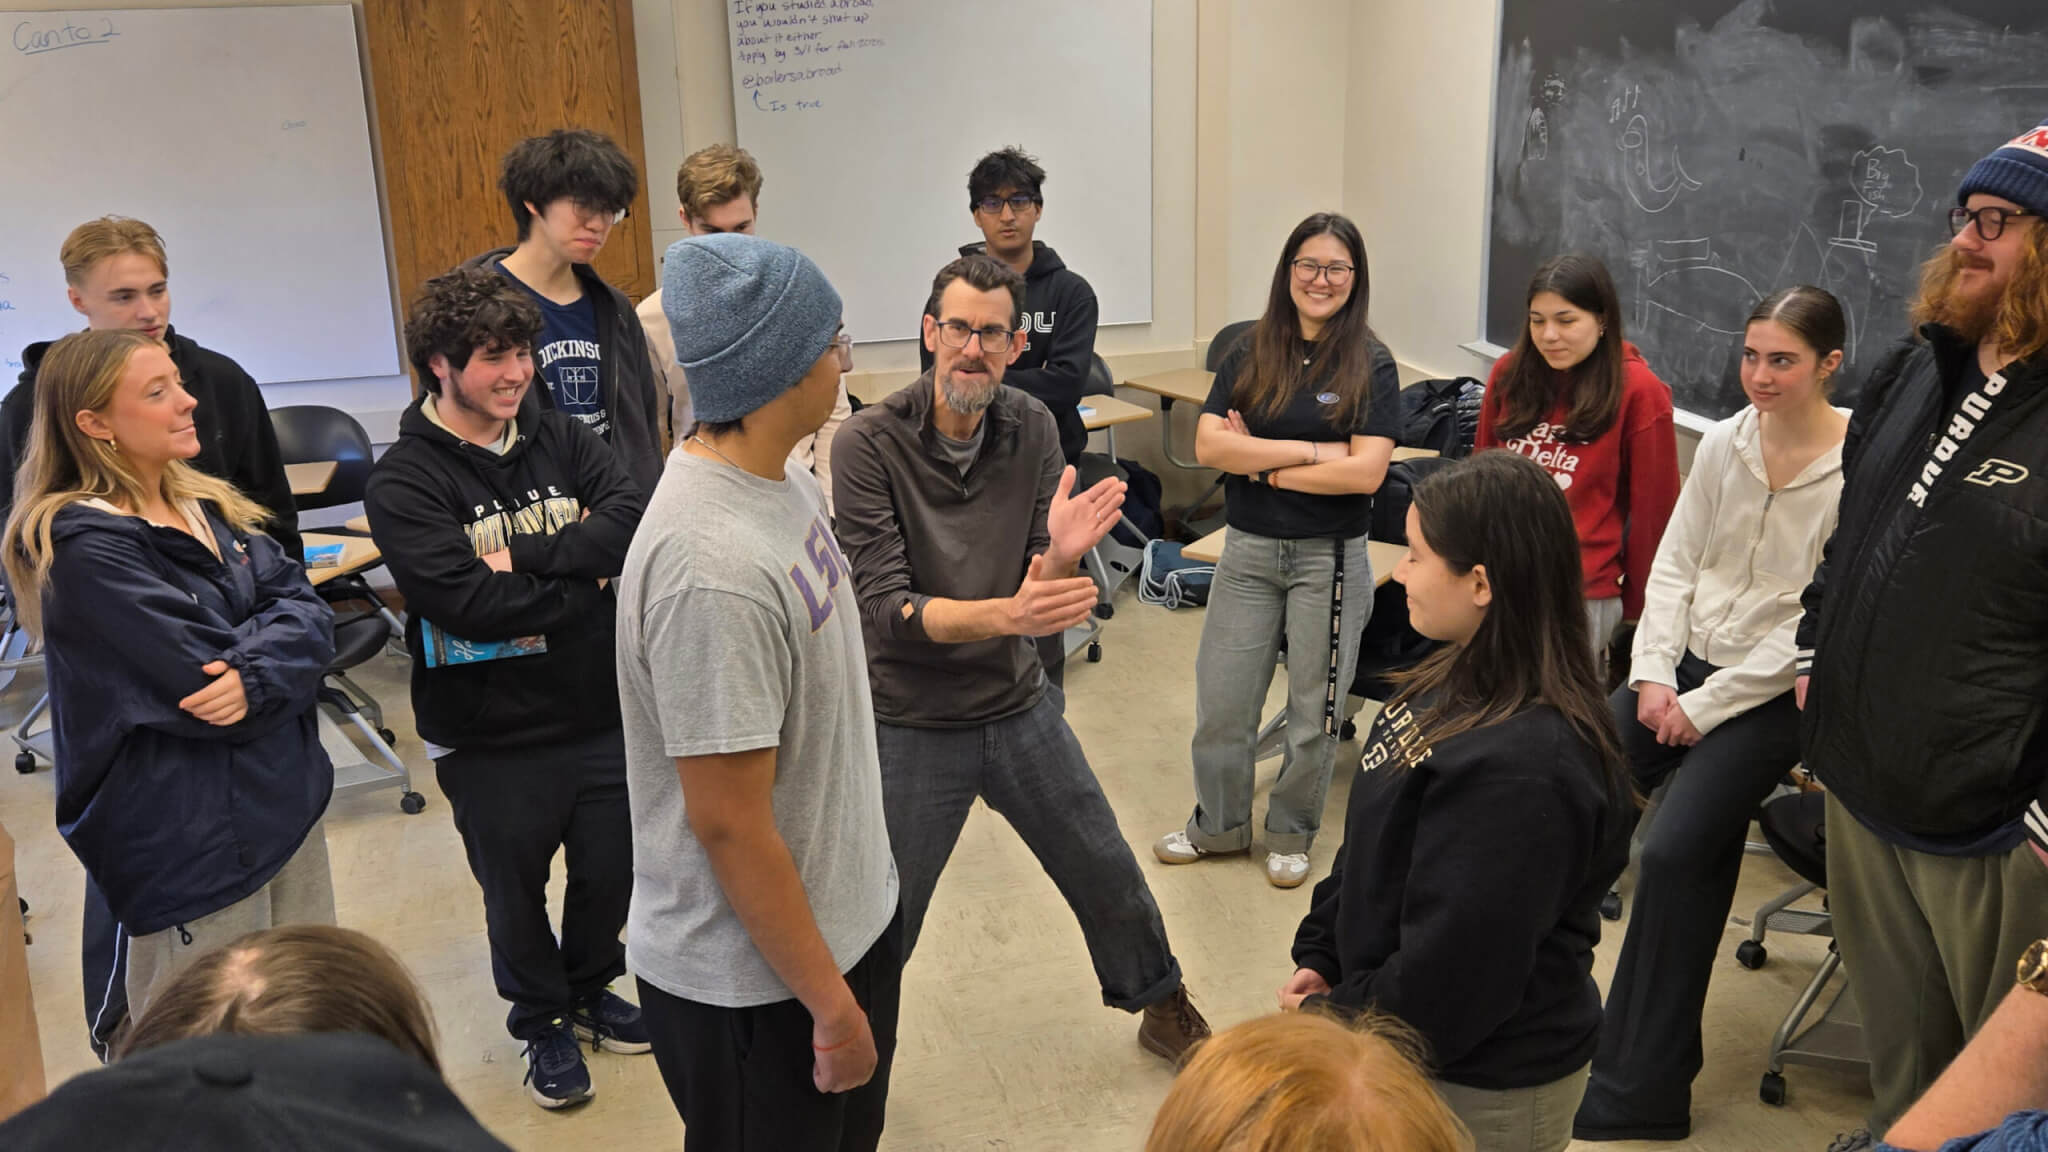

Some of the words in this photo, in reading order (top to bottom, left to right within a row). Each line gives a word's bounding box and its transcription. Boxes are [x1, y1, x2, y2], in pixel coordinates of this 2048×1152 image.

[734, 0, 752, 14] If
[756, 2, 776, 19] you
[13, 18, 91, 52] Canto
[101, 17, 121, 38] 2
[737, 20, 757, 36] you
[763, 14, 817, 28] wouldn't
[822, 12, 850, 25] shut
[855, 12, 869, 25] up
[737, 34, 772, 47] about
[775, 33, 783, 43] it
[786, 31, 822, 41] either
[775, 48, 786, 63] by
[769, 101, 787, 112] Is
[1906, 372, 2008, 508] PURDUE
[1385, 702, 1433, 768] URDUE
